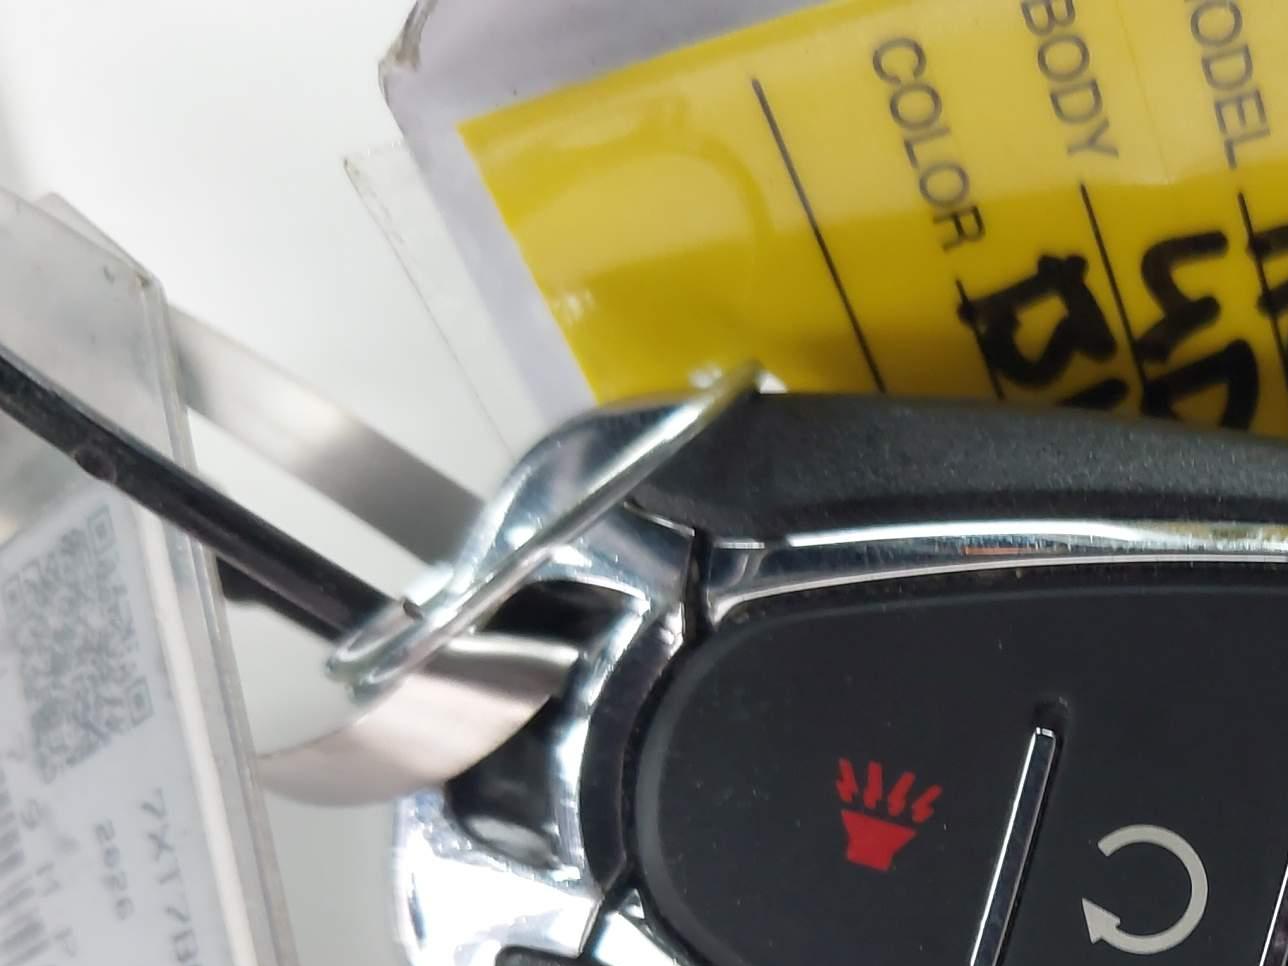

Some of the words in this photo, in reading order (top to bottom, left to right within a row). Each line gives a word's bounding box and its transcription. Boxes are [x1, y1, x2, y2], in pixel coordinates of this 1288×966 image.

[872, 36, 985, 252] COLOR
[1020, 0, 1118, 158] BODY
[1187, 0, 1270, 170] ODEL
